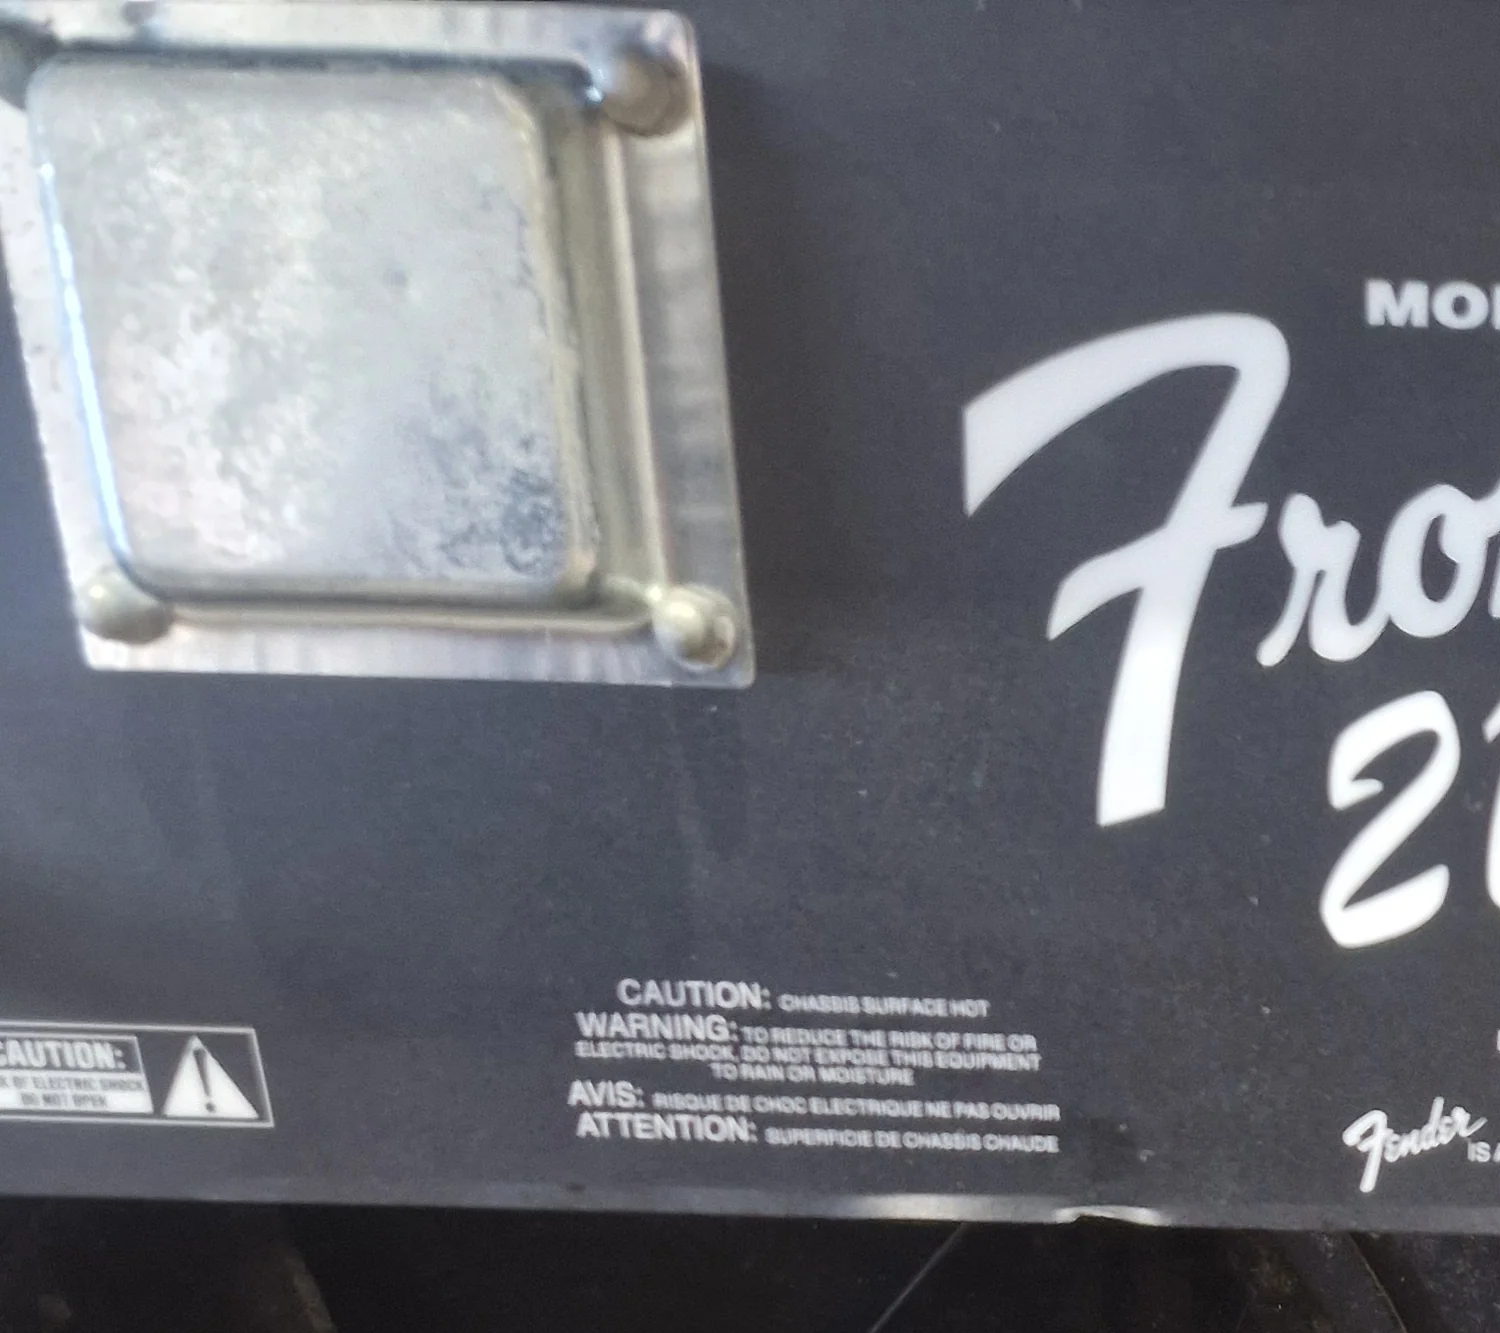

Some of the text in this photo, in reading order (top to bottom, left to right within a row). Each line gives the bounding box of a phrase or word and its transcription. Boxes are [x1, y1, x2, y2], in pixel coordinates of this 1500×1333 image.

[616, 978, 772, 1011] CAUTION:
[573, 1010, 739, 1043] WARNING:
[566, 1079, 646, 1110] AVIS:
[575, 1111, 759, 1144] ATTENTION:
[1342, 1096, 1488, 1193] Fender
[1467, 1141, 1492, 1164] IS
